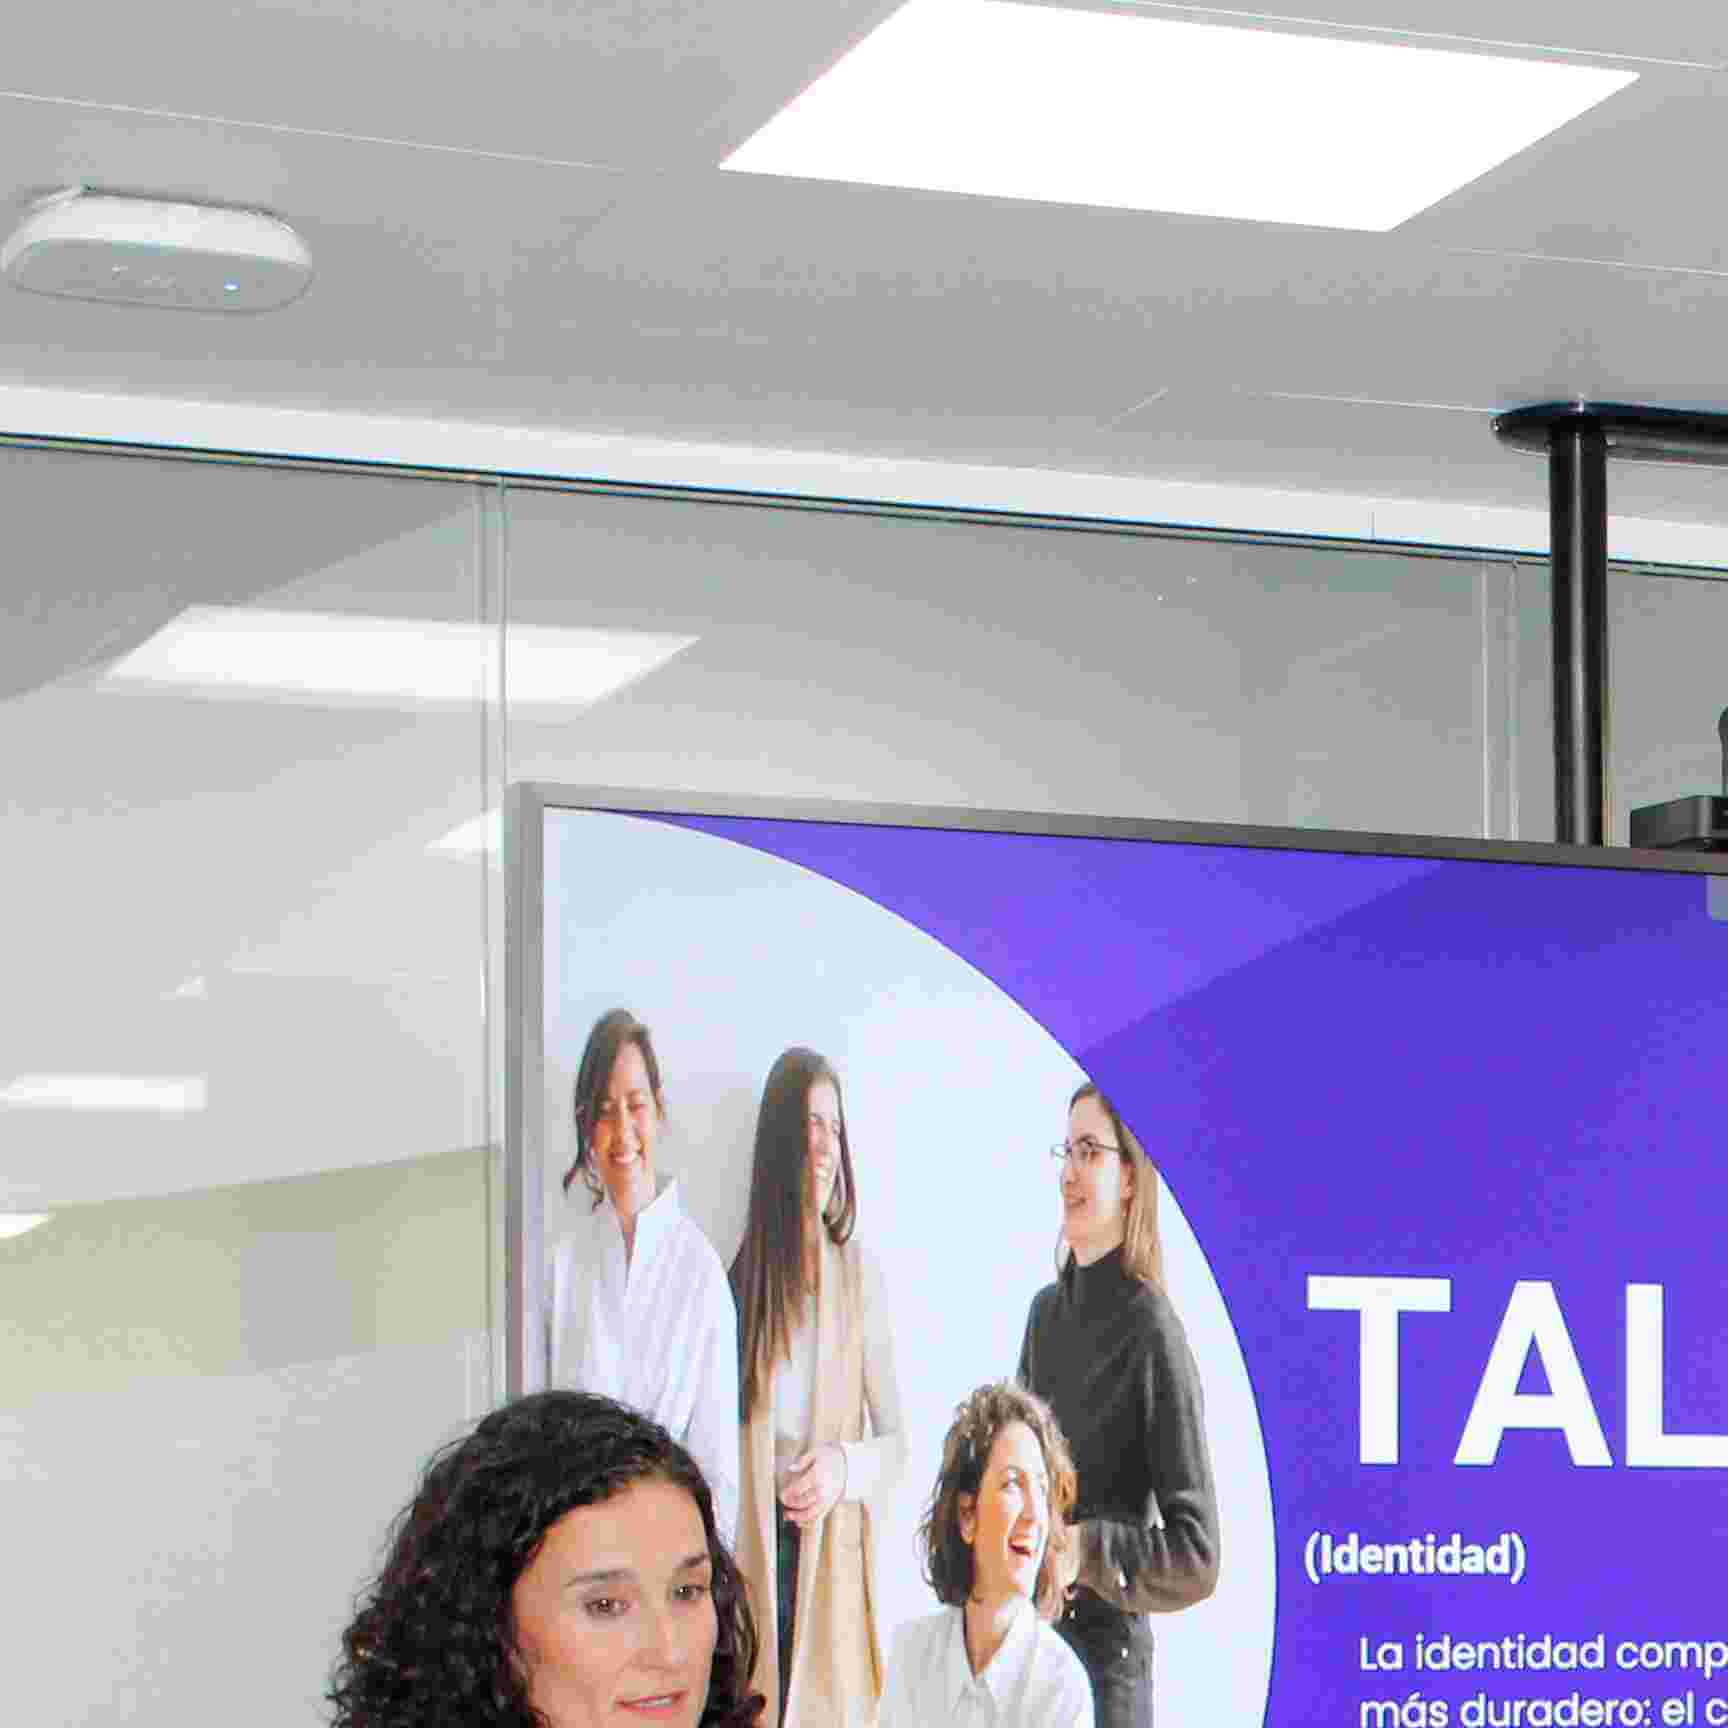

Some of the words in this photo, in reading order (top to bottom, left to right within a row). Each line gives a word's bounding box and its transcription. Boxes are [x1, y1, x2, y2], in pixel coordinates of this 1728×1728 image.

[1304, 1531, 1526, 1585] (Identidad)
[1359, 1637, 1403, 1671] La
[1415, 1632, 1605, 1671] identidad
[1360, 1692, 1449, 1728] más
[1460, 1691, 1651, 1728] duradero:
[1661, 1691, 1694, 1727] el
